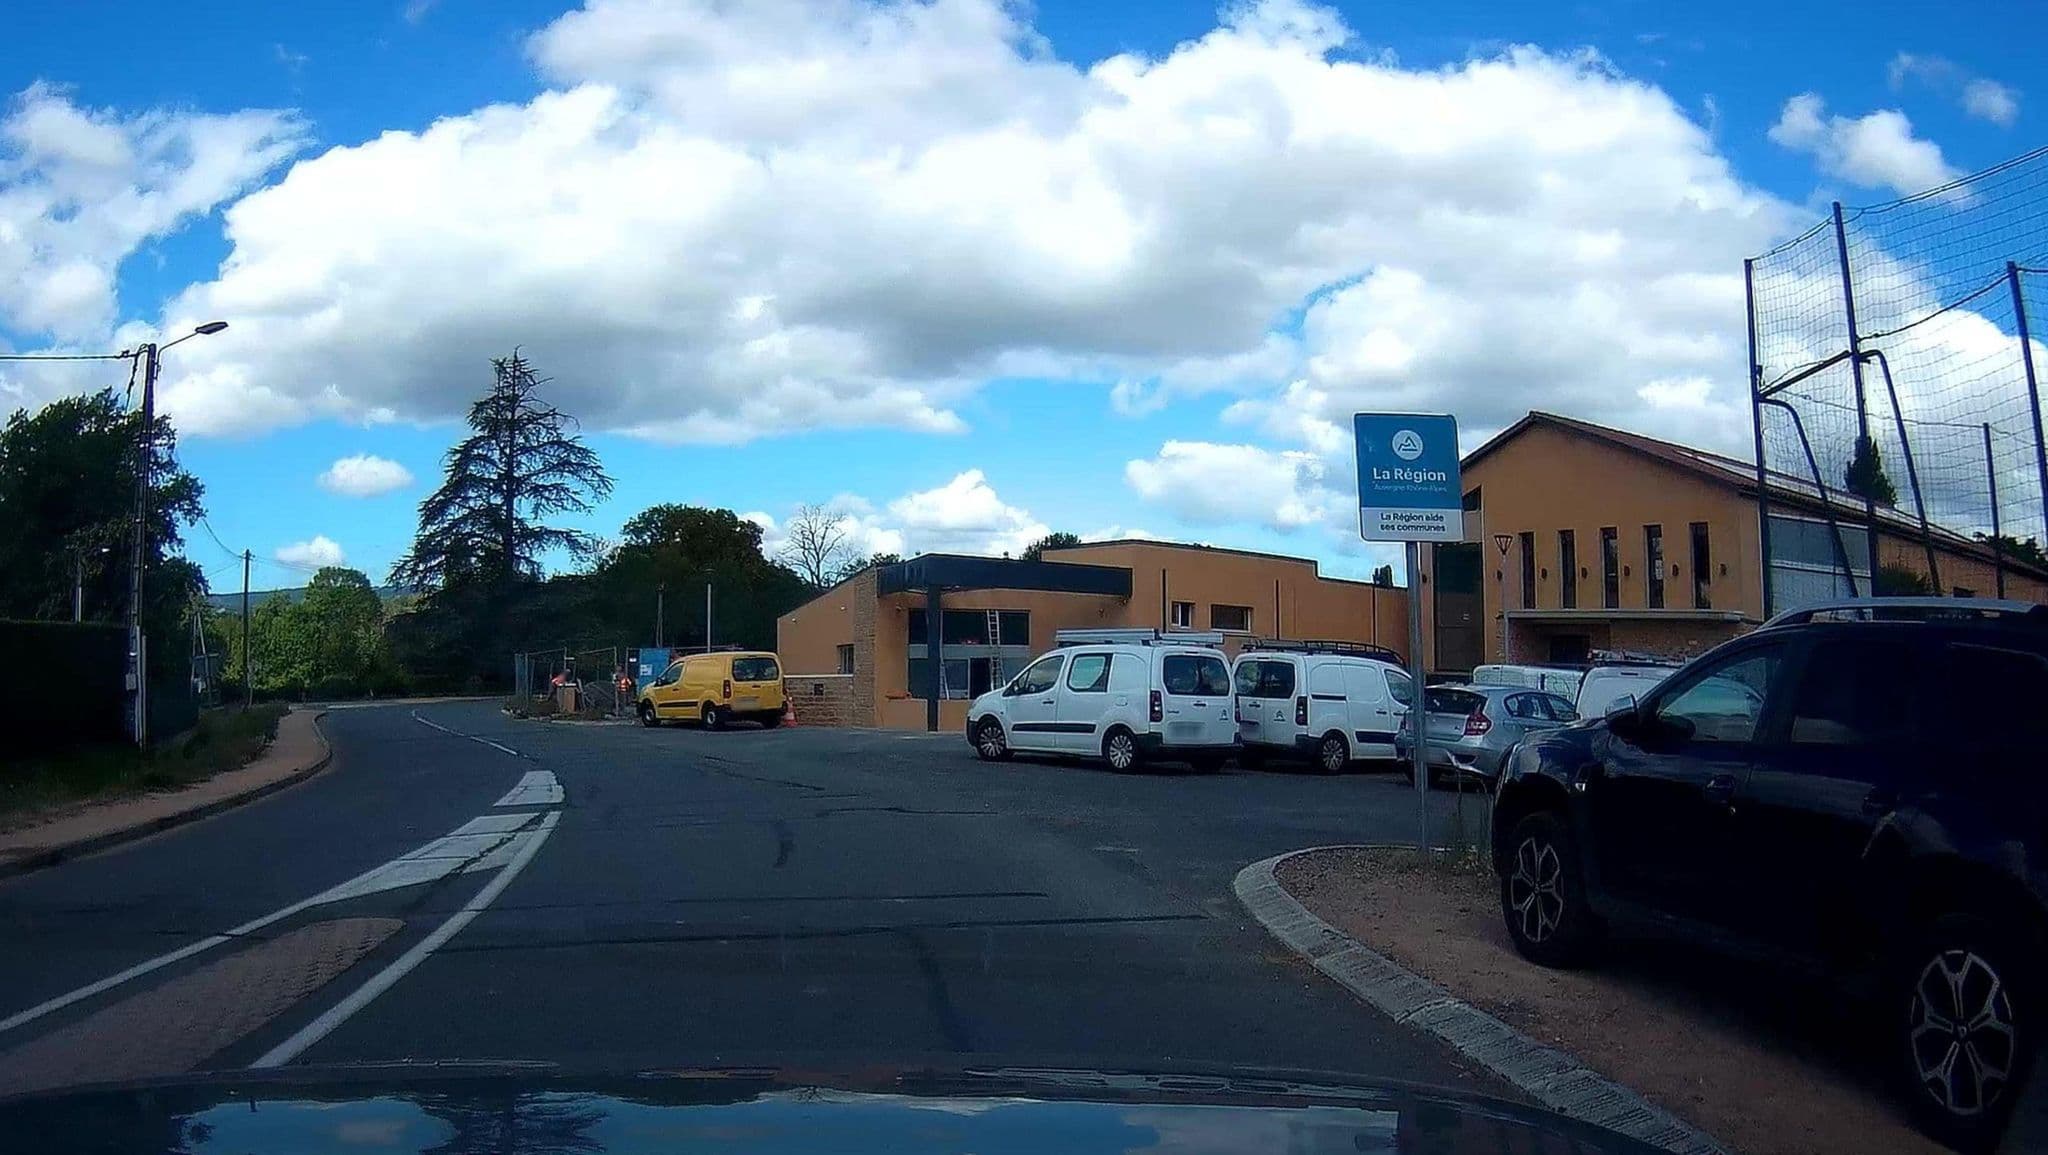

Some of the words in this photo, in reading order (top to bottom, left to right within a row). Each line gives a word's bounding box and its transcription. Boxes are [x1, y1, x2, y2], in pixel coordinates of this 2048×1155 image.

[1373, 468, 1390, 480] La
[1394, 467, 1447, 483] Région
[1380, 512, 1392, 521] La
[1393, 513, 1424, 522] Région
[1425, 514, 1444, 522] aide
